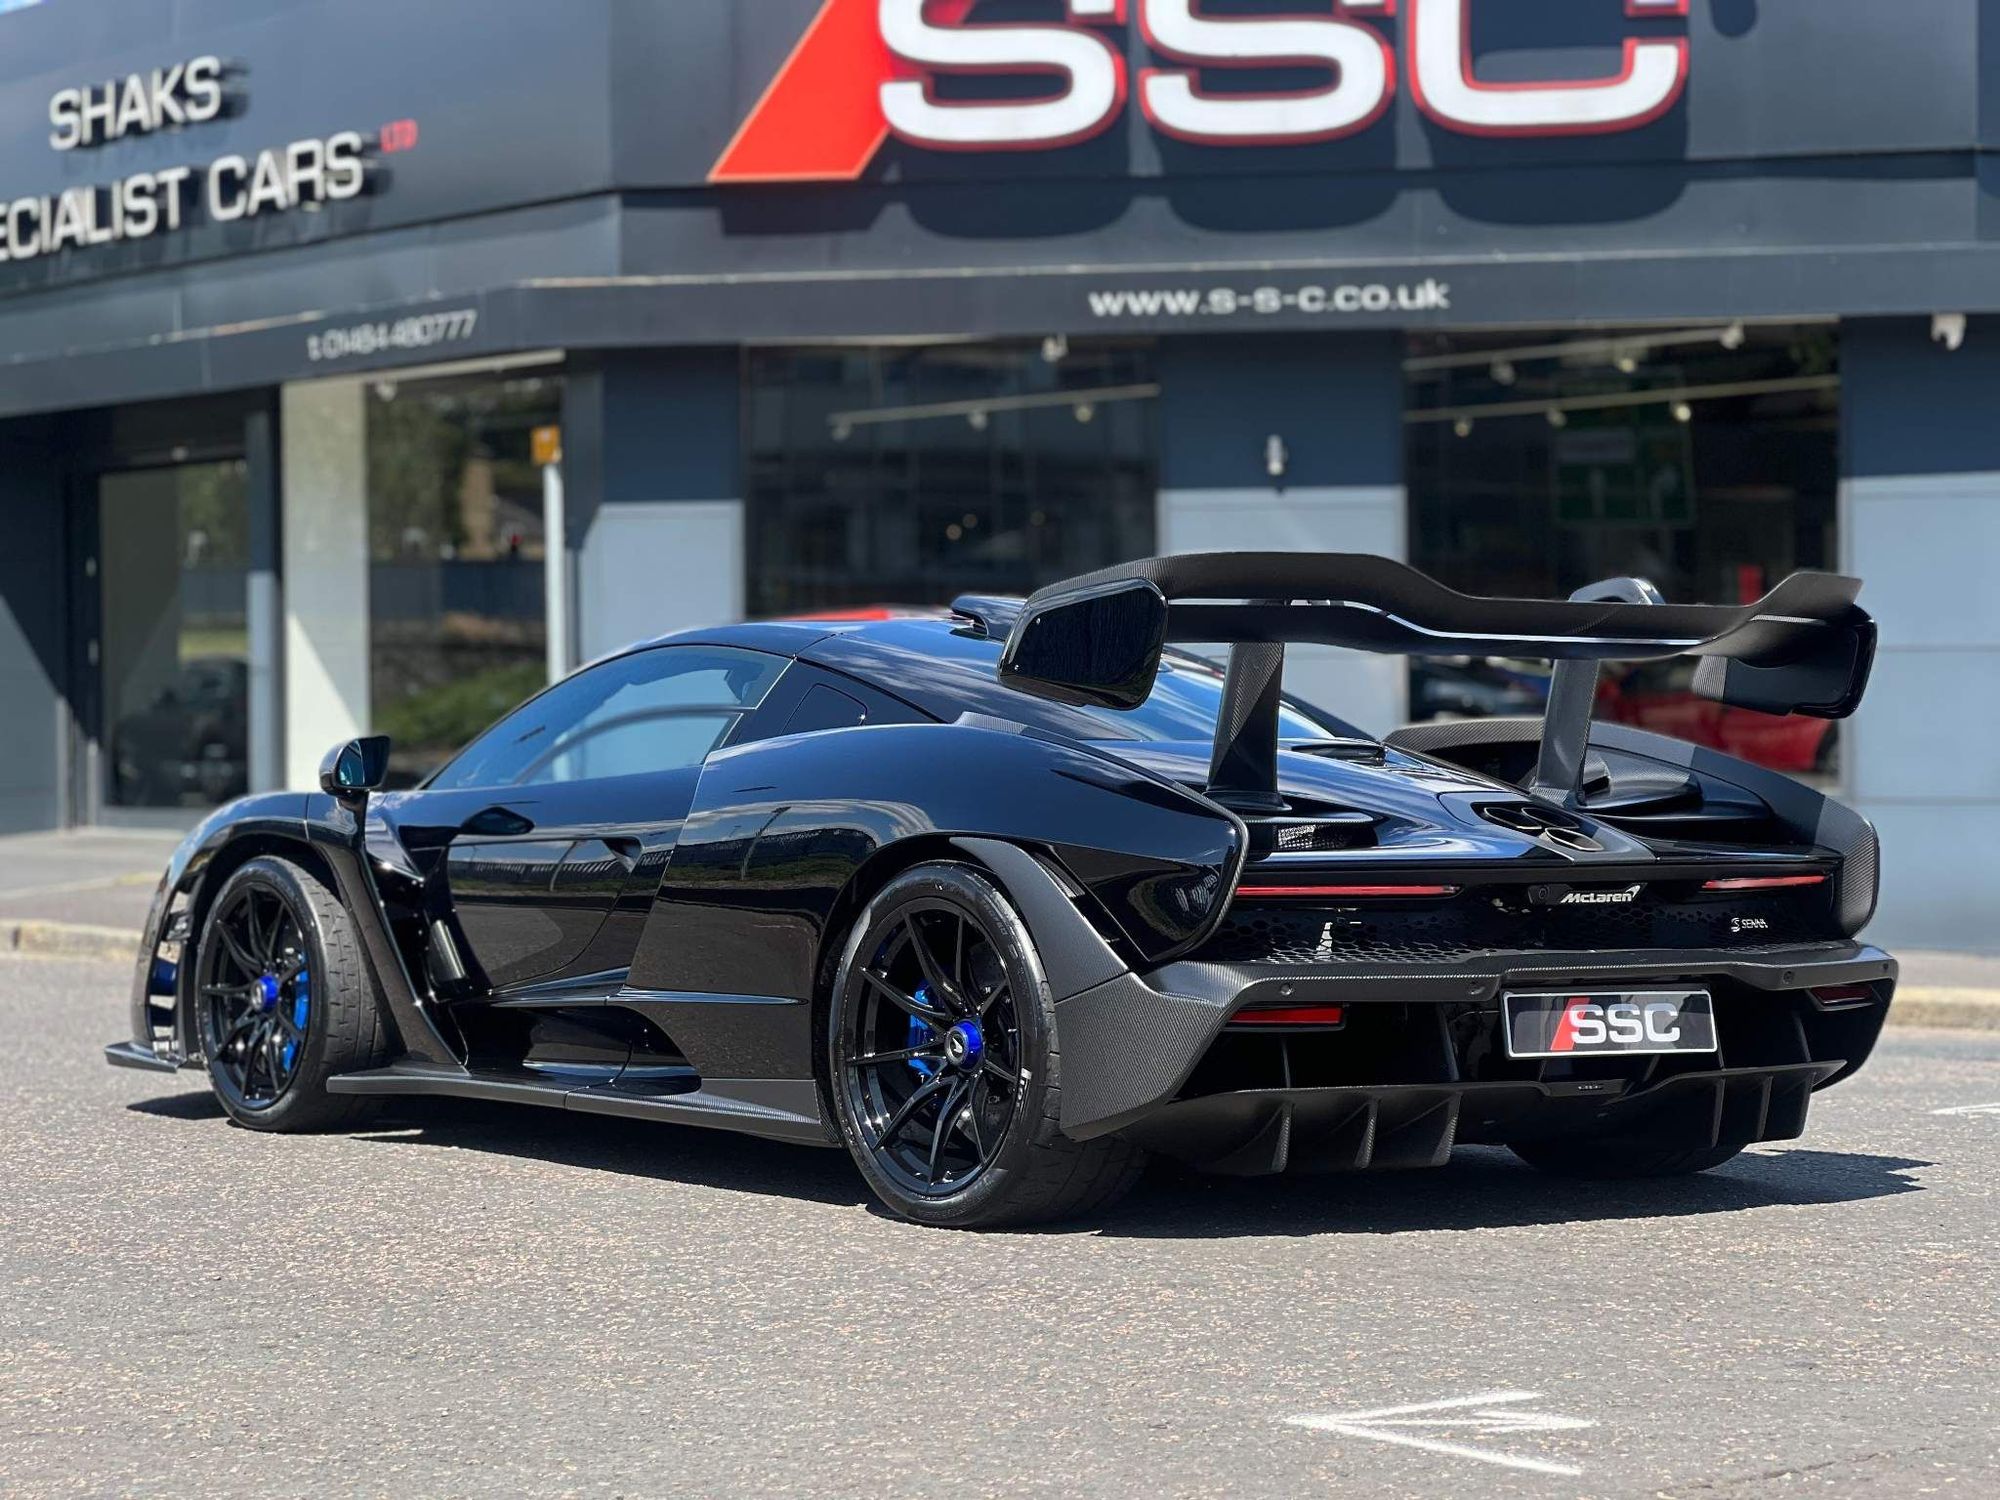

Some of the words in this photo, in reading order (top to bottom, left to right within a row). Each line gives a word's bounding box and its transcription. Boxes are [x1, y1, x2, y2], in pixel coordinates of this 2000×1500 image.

[49, 55, 221, 150] SHAKS
[878, 0, 1688, 152] SSC
[208, 130, 363, 221] CARS
[1088, 278, 1450, 317] www.s-s-c.co.uk
[1560, 892, 1632, 903] McLaren
[1569, 1002, 1681, 1044] SSC
